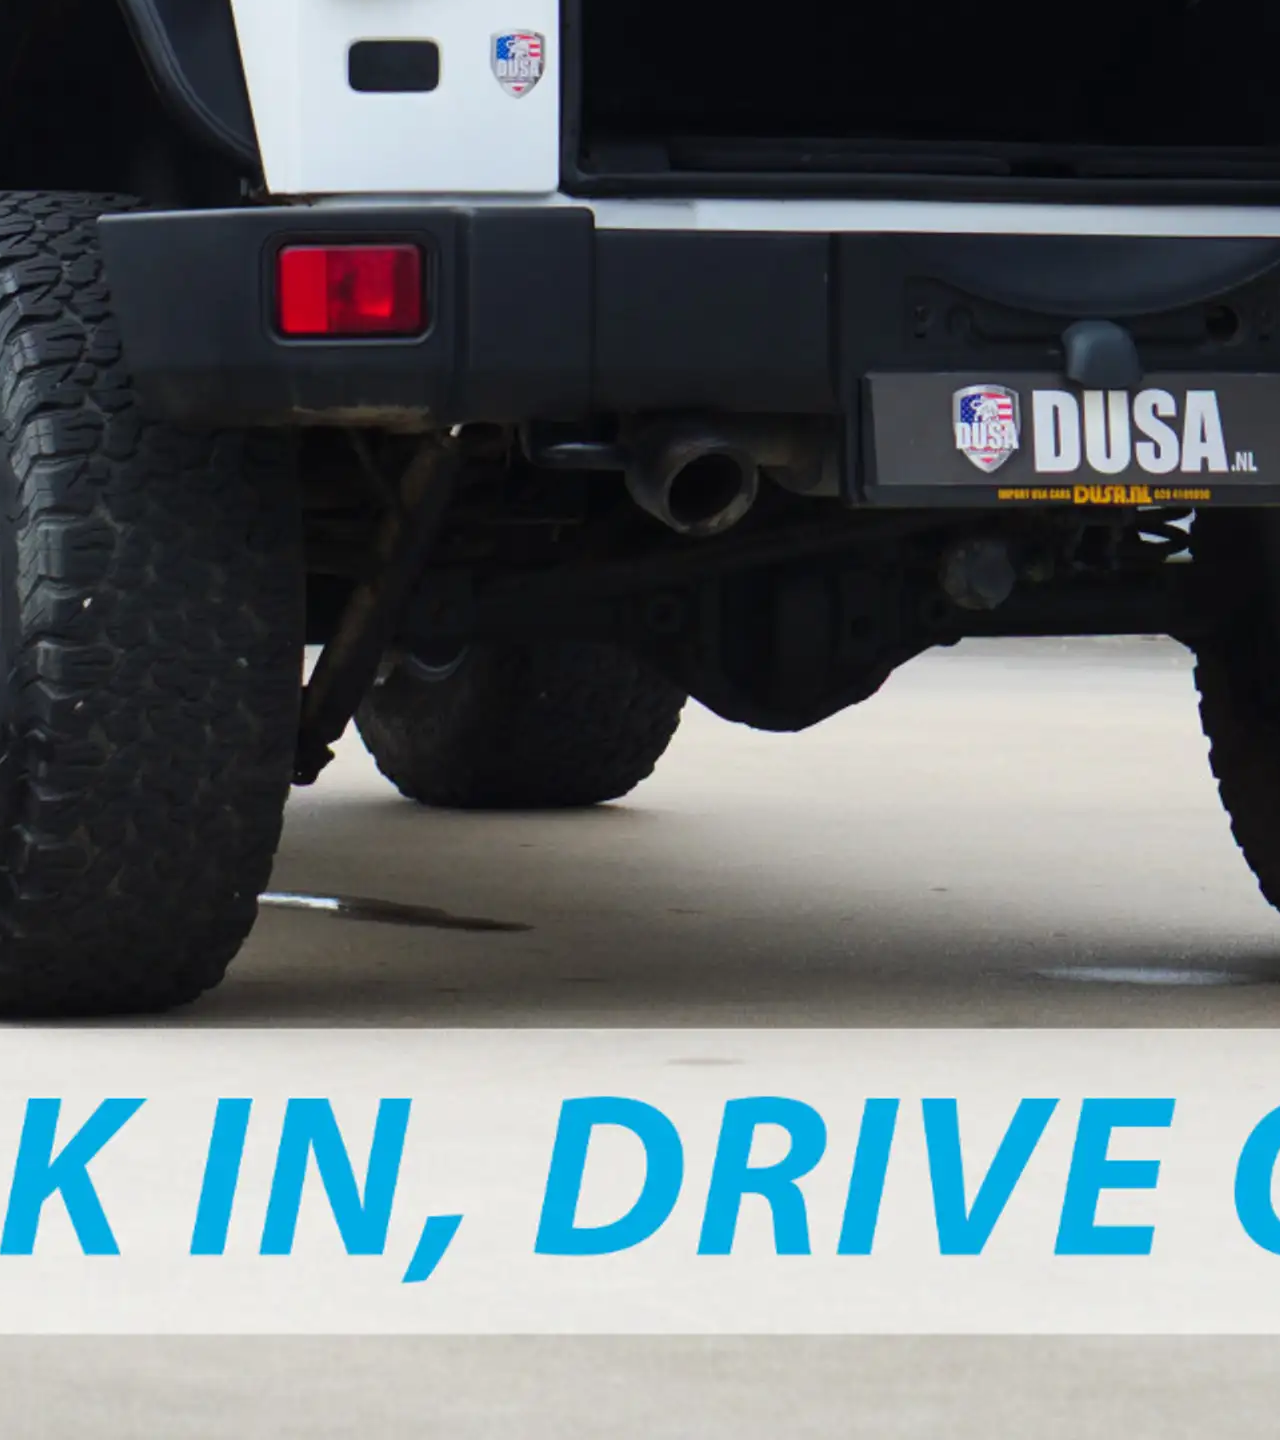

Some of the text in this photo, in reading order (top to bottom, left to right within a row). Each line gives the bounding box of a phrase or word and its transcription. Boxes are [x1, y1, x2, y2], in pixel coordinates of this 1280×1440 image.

[955, 422, 1019, 449] DUSA
[1032, 389, 1258, 474] DUSA .NL
